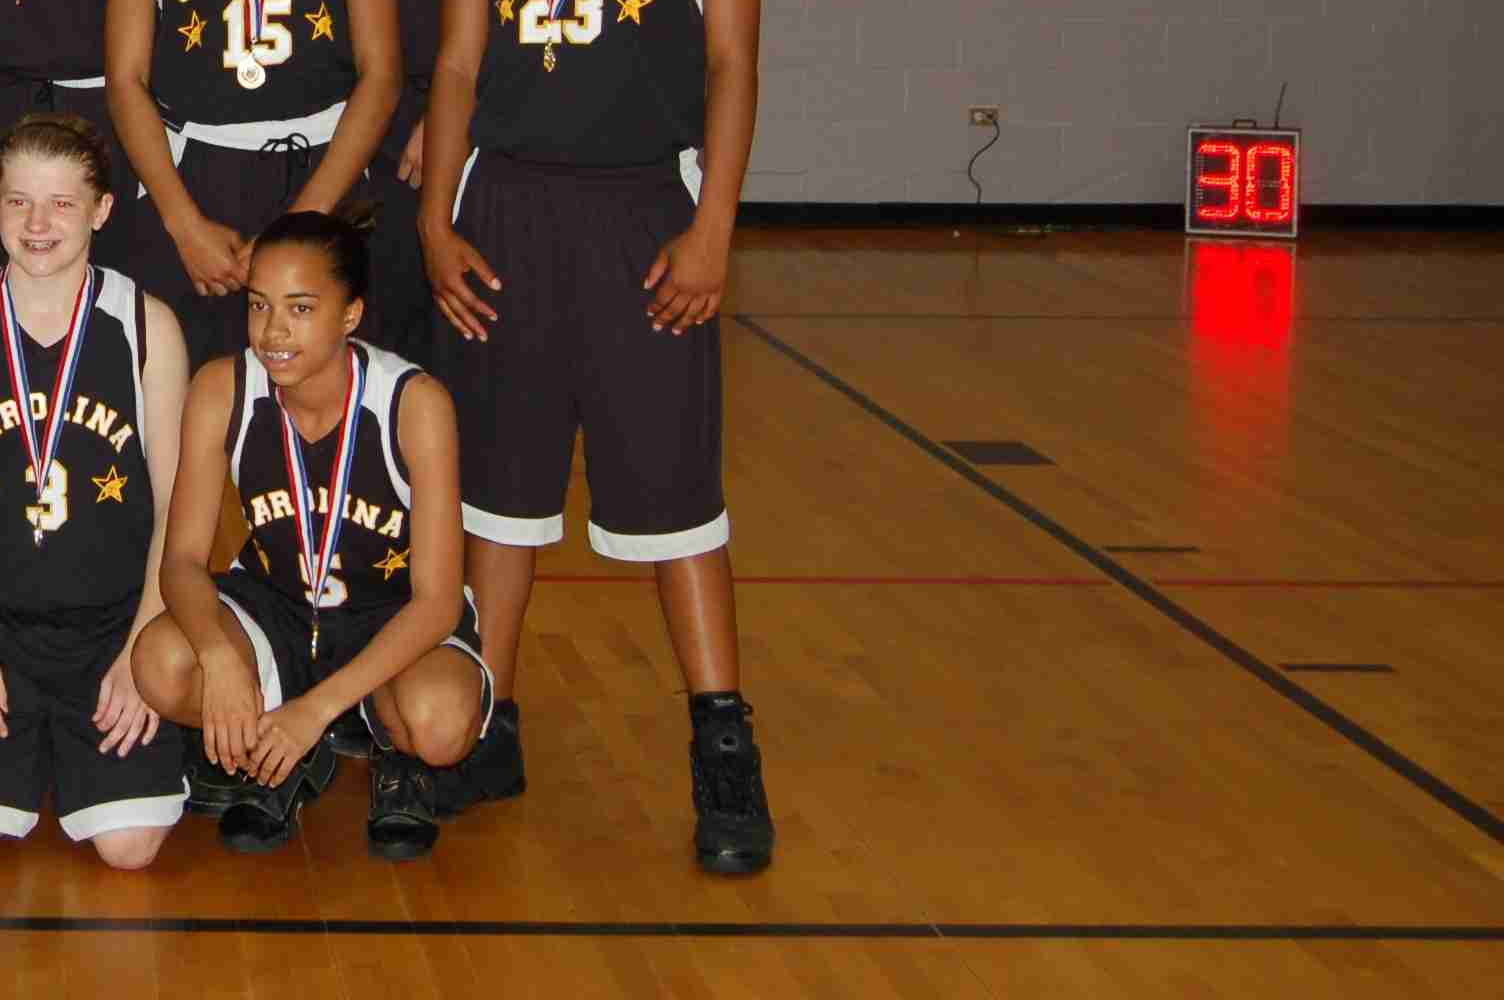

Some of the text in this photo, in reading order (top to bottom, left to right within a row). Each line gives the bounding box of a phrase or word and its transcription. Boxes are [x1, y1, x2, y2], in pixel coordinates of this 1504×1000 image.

[1198, 143, 1291, 219] 30
[25, 458, 69, 532] 3
[298, 552, 349, 608] 5
